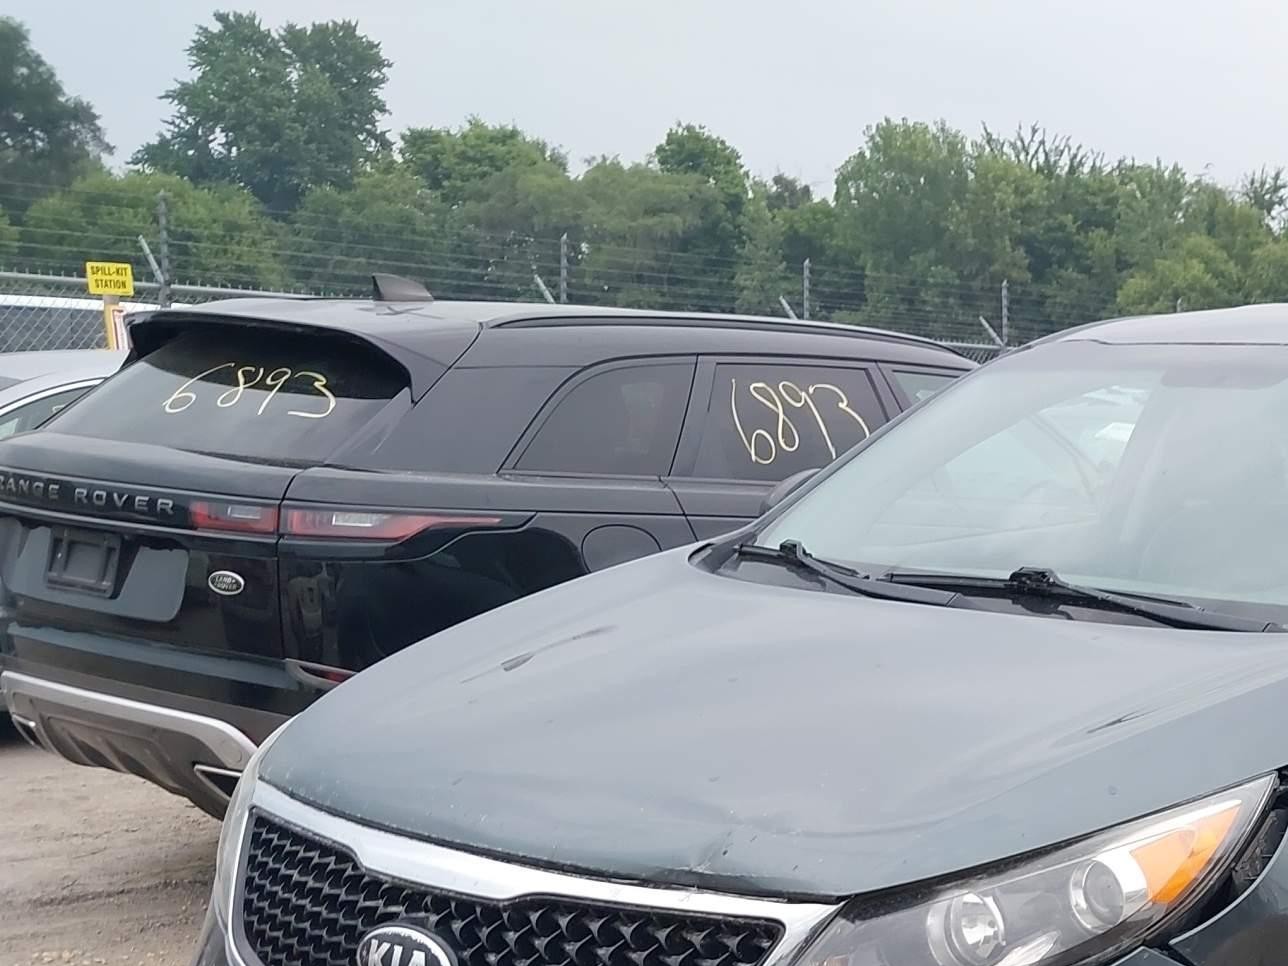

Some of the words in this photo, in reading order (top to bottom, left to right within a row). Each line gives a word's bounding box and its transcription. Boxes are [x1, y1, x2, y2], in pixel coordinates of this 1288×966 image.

[90, 265, 128, 277] SPILL-KIT
[94, 279, 127, 289] STATION
[162, 362, 336, 418] 6893
[731, 378, 870, 464] 6893
[74, 487, 175, 515] ROVER
